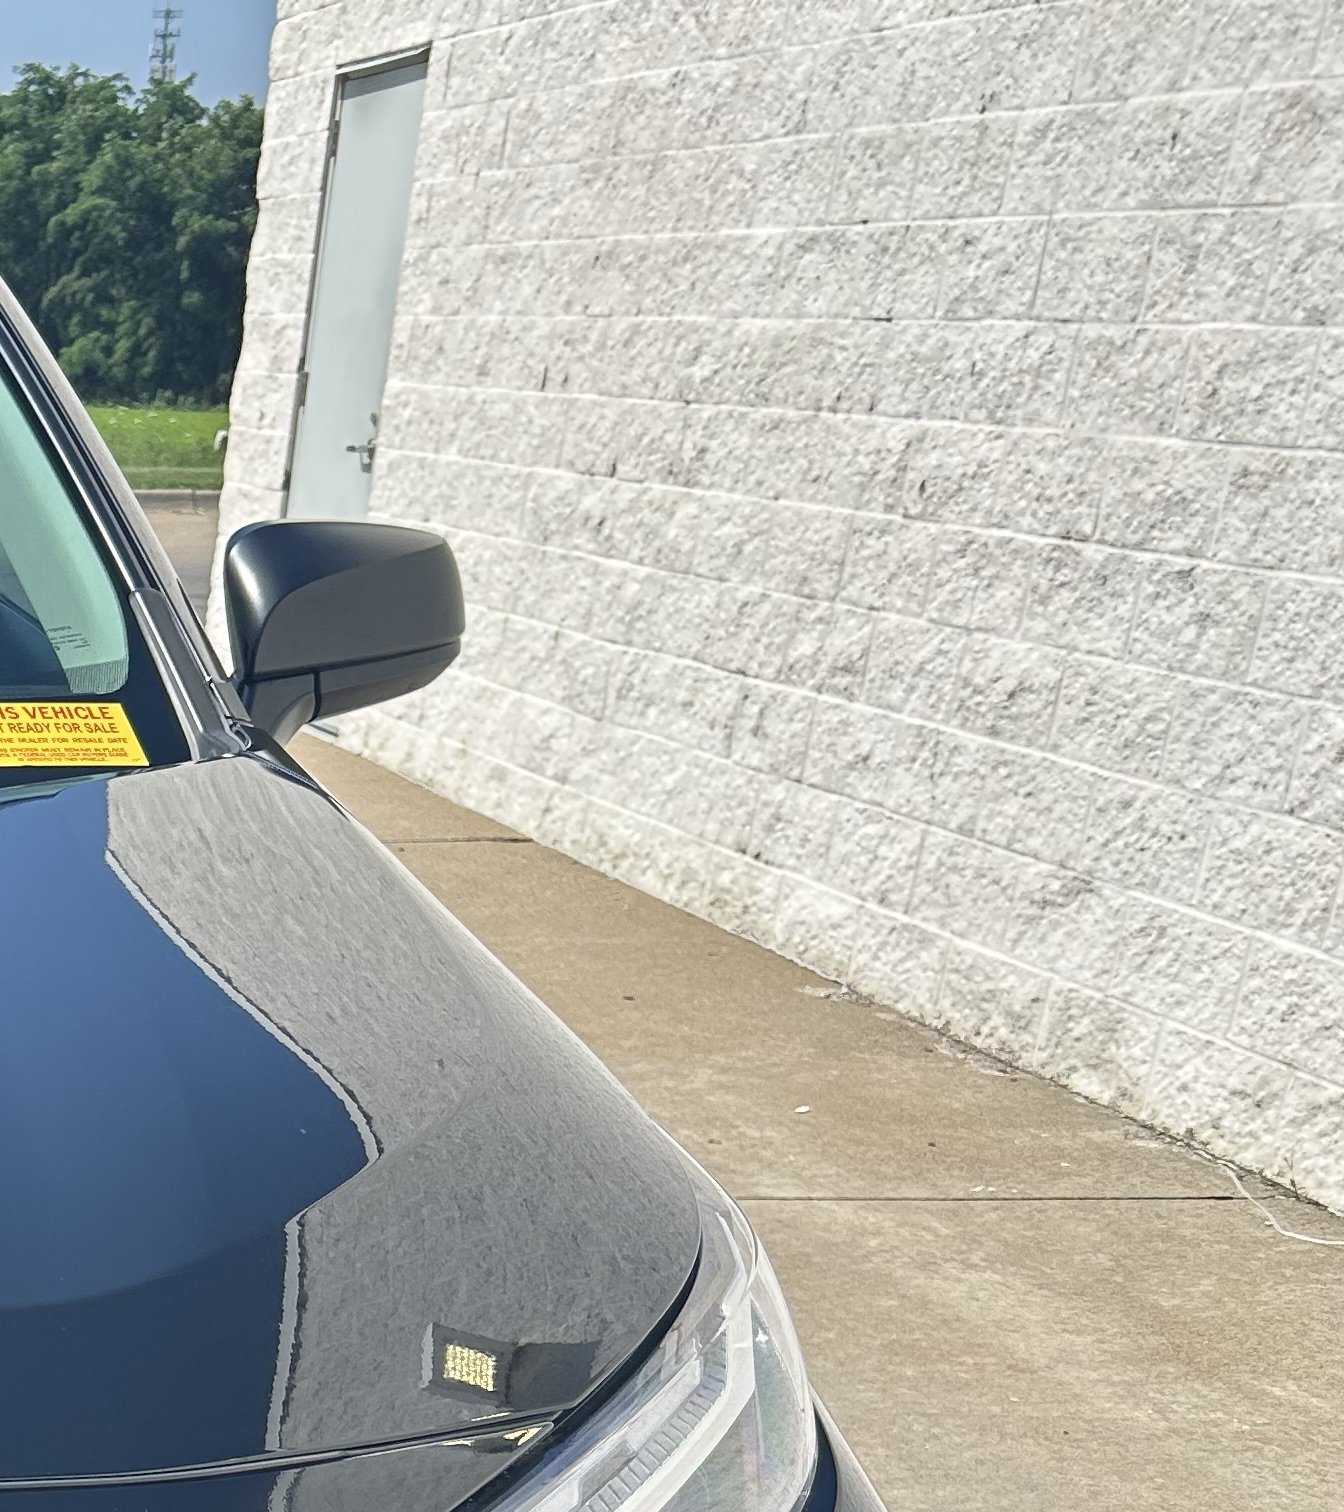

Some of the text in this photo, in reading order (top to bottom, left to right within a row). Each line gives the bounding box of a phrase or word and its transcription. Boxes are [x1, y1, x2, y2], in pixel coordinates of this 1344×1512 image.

[21, 706, 114, 720] VEHICLE
[7, 722, 51, 734] READY
[54, 722, 81, 734] FOR
[86, 722, 120, 734] SALE
